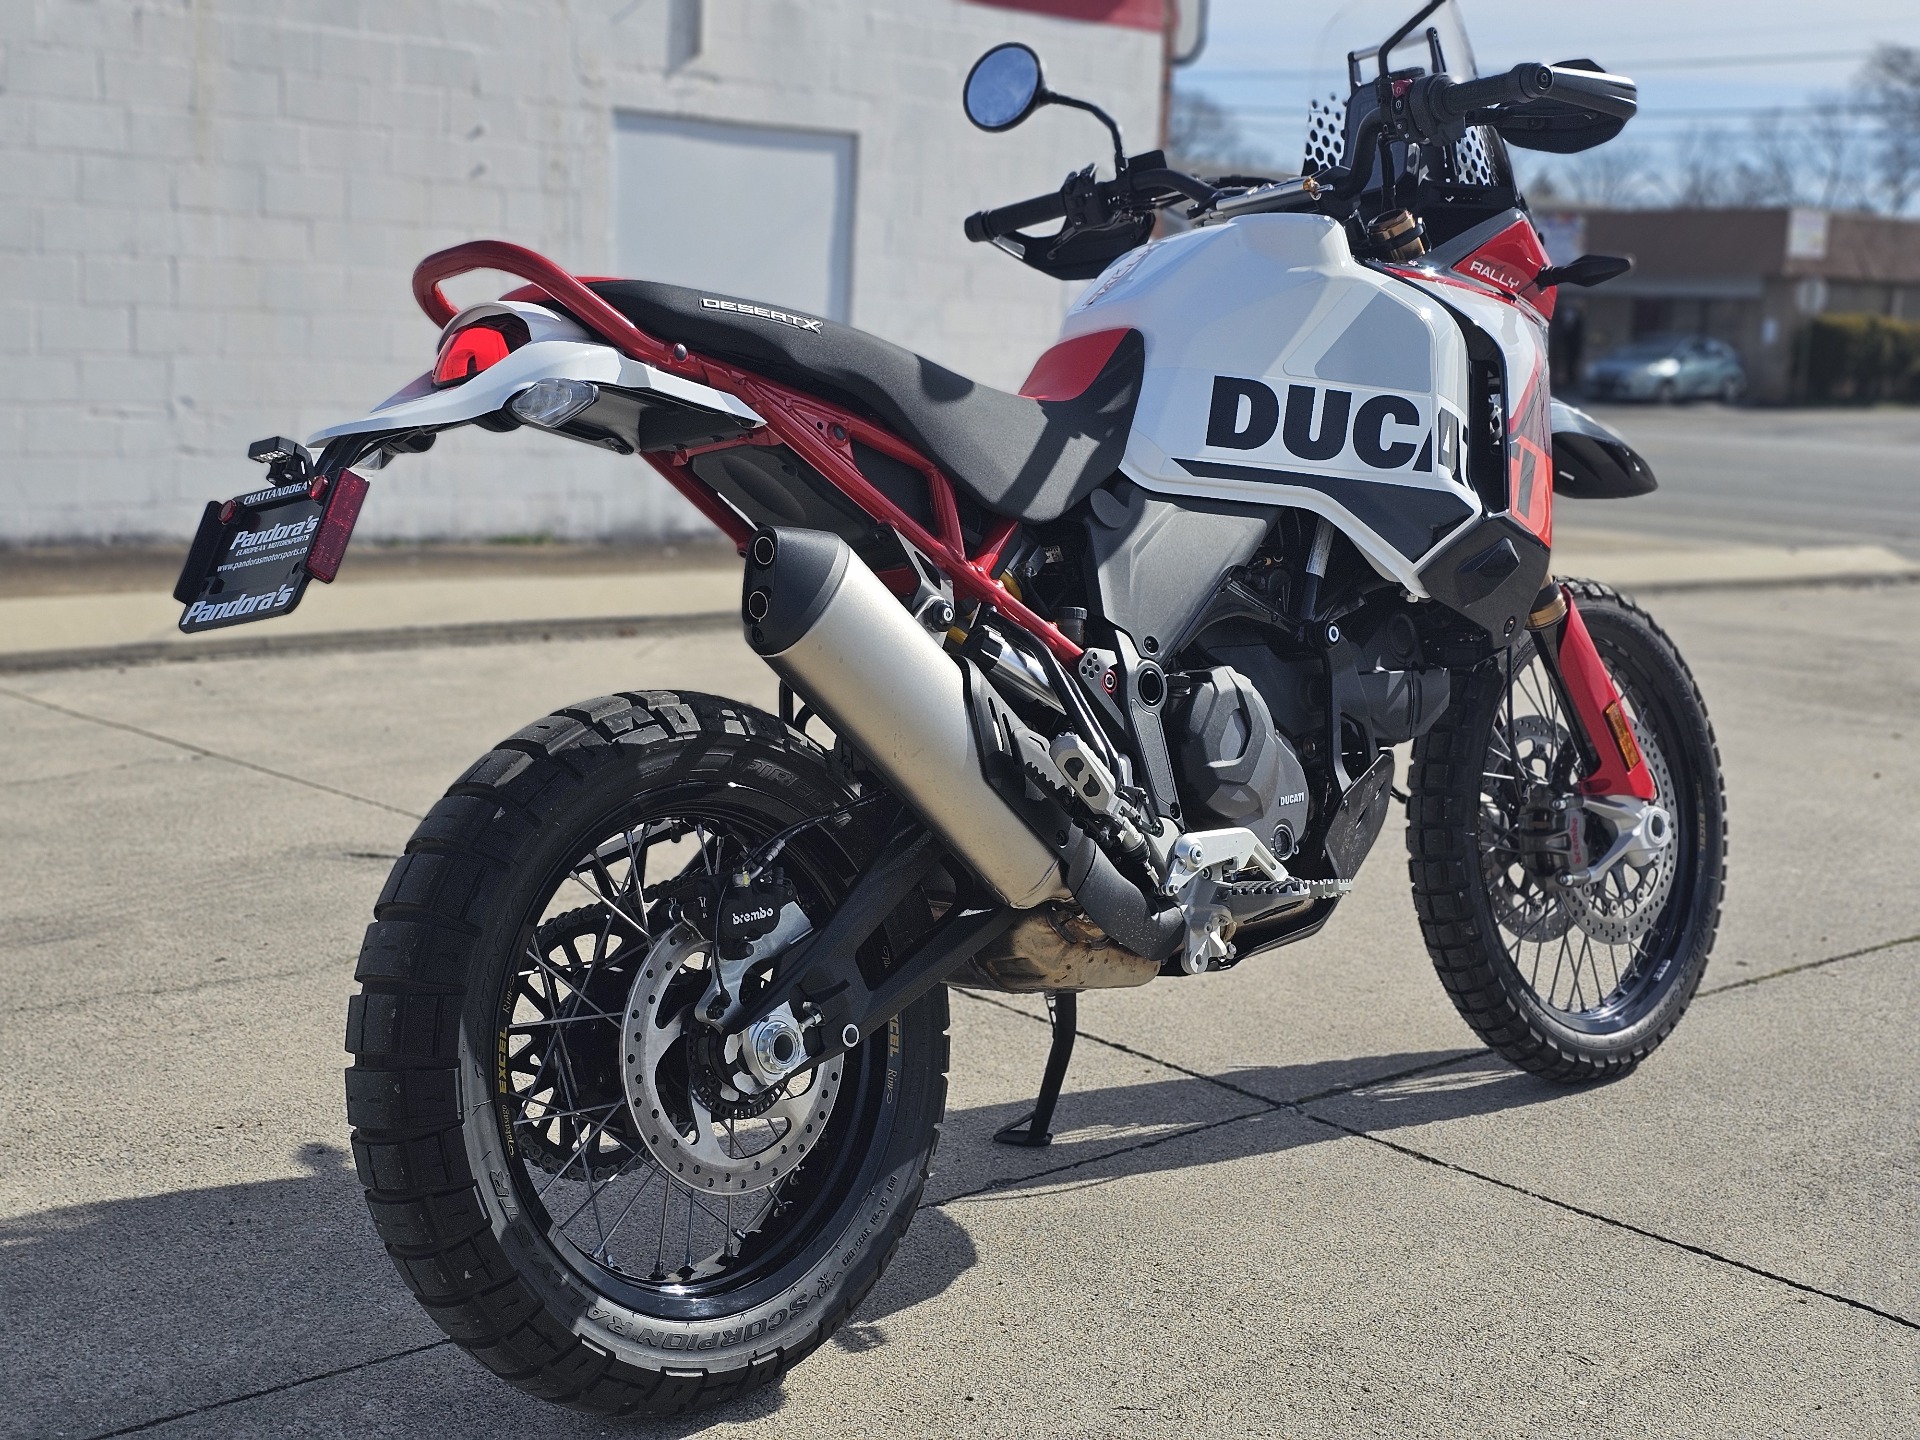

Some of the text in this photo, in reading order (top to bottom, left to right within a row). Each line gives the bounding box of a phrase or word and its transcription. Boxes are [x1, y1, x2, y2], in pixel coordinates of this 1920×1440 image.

[1469, 260, 1520, 289] RALLY
[700, 297, 825, 335] DESERTX
[1205, 374, 1469, 482] DUCA
[243, 480, 309, 506] CHATTANOOGA
[229, 514, 320, 551] Pandora's
[216, 546, 308, 573] www.pandorasmotorsports.co
[181, 583, 295, 626] Pandora's
[1279, 791, 1305, 807] DUCATI
[732, 906, 775, 926] brembo
[888, 1013, 900, 1058] XCEL
[498, 1026, 508, 1094] EXCEL
[636, 1292, 809, 1352] SCORPION
